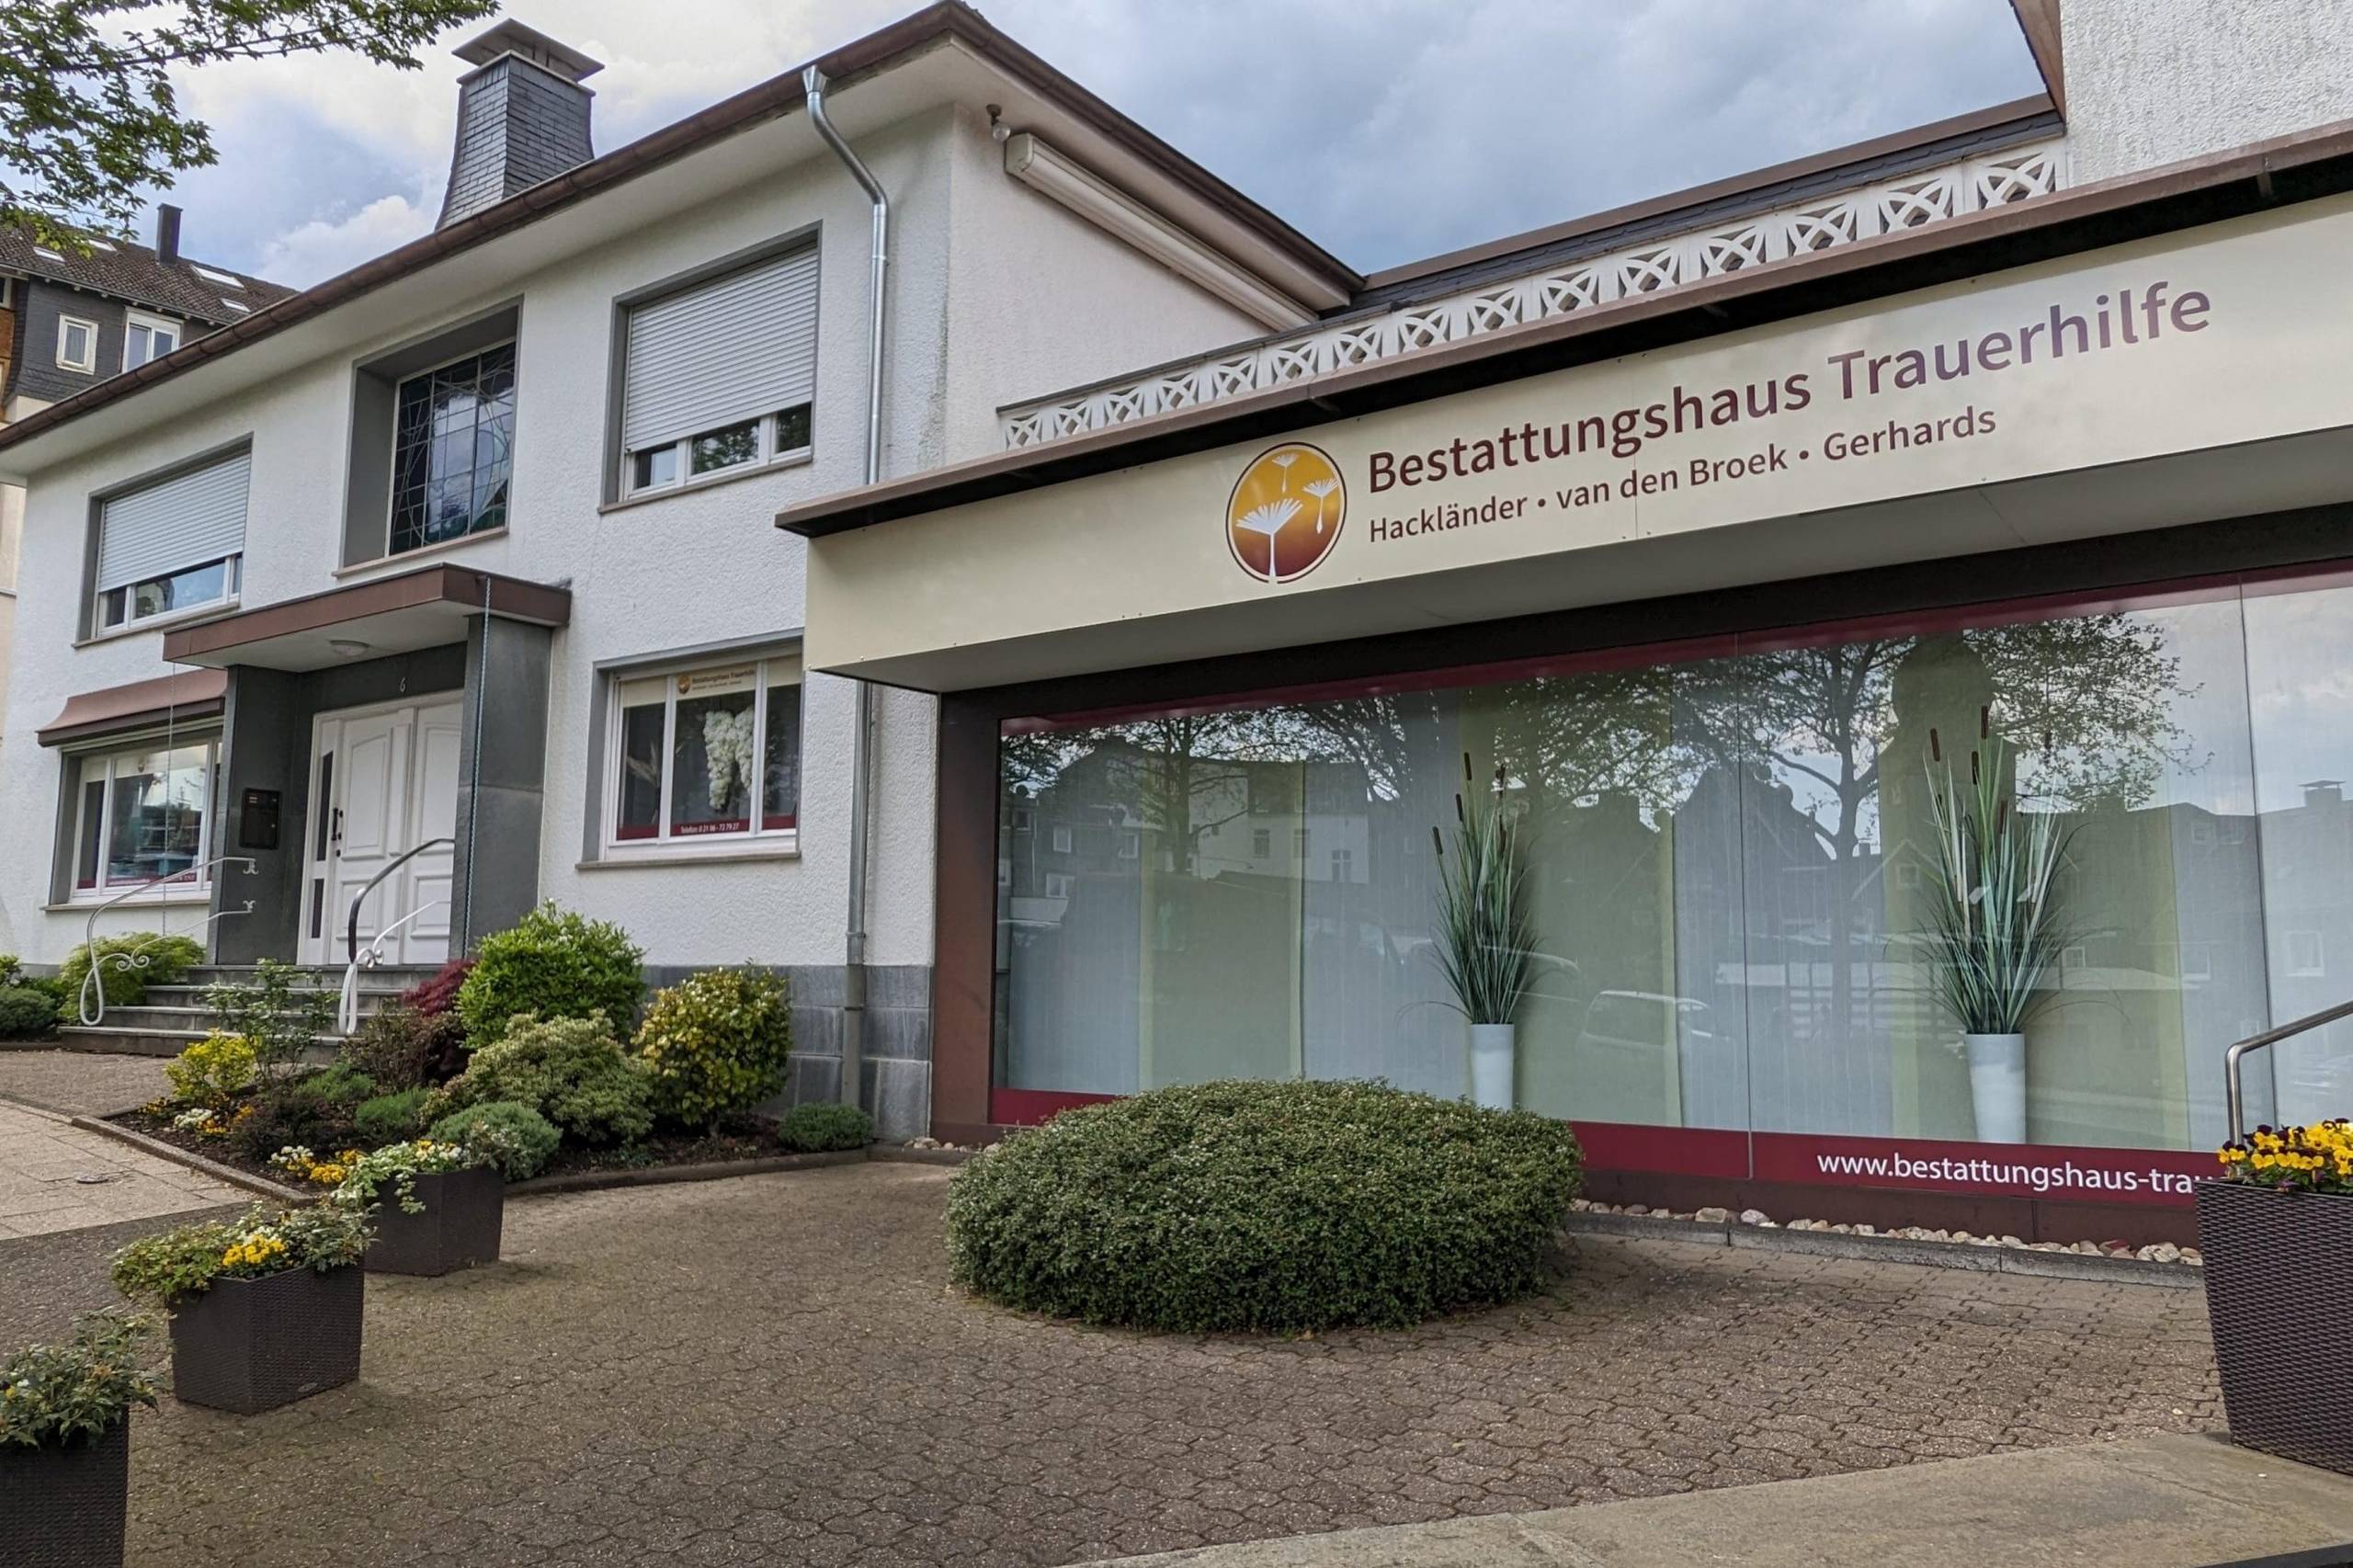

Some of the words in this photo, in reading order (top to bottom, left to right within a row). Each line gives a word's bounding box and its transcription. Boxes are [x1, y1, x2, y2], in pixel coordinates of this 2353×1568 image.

[1370, 373, 1812, 494] Bestattungshaus
[1827, 280, 2211, 400] Trauerhilfe
[1370, 495, 1529, 543] Hackländer
[1555, 483, 1610, 510] van
[1620, 469, 1678, 499] den
[1689, 442, 1789, 487] Broek
[1824, 404, 1996, 461] Gerhards
[400, 676, 405, 692] 6
[1816, 1152, 2213, 1194] www.bestattungshaus-tra
